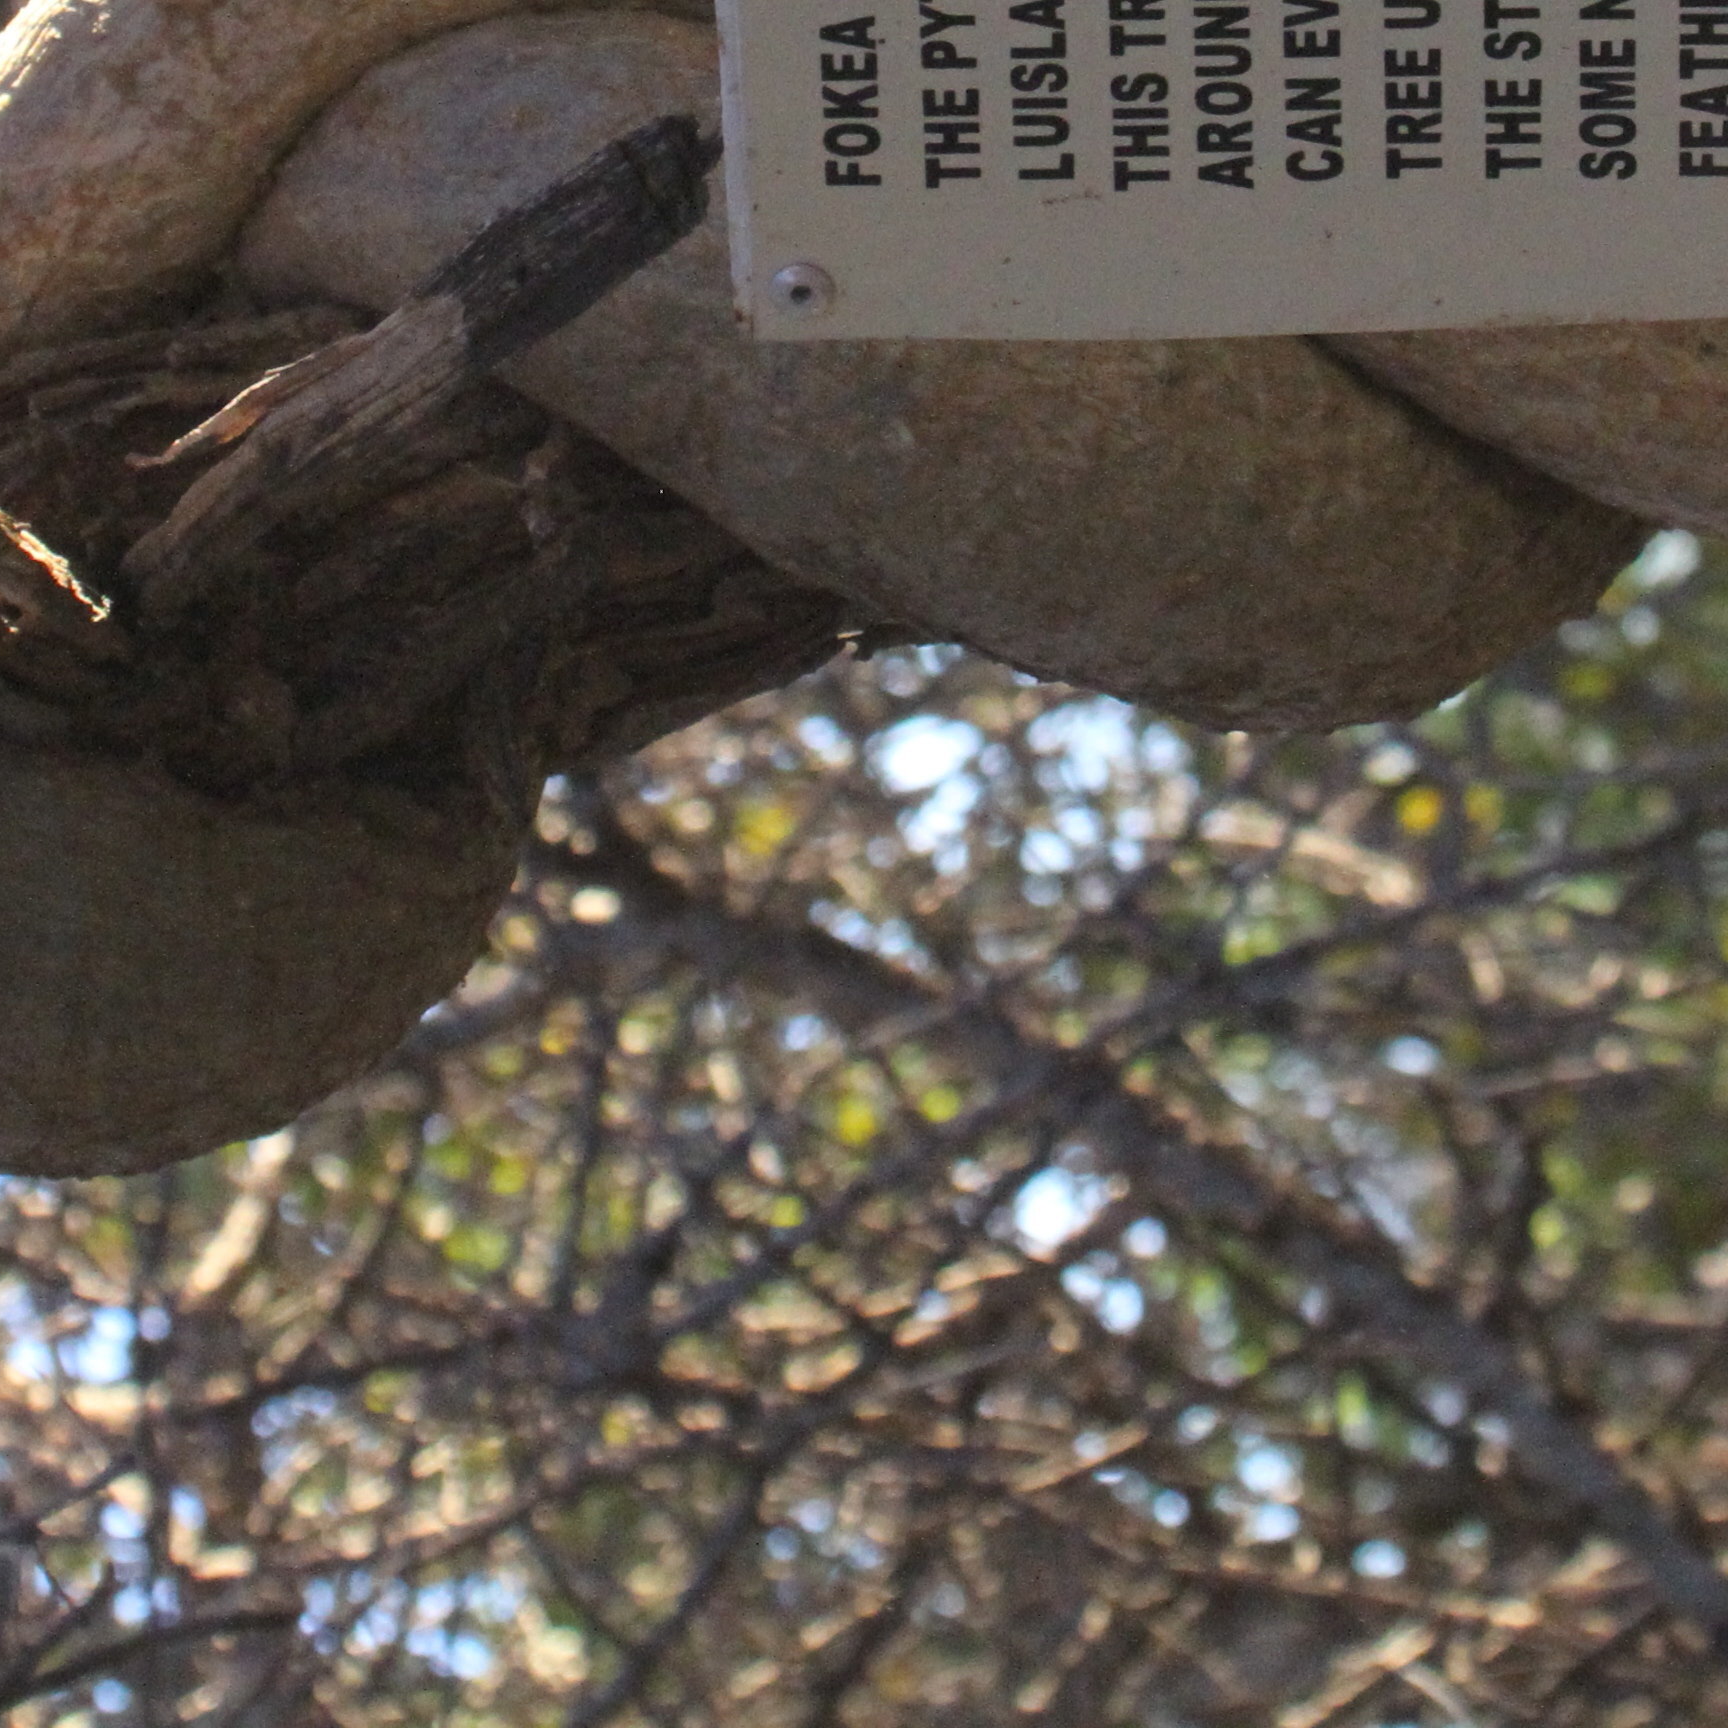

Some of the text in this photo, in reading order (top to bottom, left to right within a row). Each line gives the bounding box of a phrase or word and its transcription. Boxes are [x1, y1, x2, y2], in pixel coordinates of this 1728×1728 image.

[819, 16, 882, 186] FOKEA
[922, 88, 982, 189] THE
[1110, 73, 1170, 192] THIS
[1285, 77, 1344, 182] CAN
[1384, 48, 1443, 179] TREE
[1484, 78, 1542, 179] THE
[1579, 39, 1637, 180] SOME
